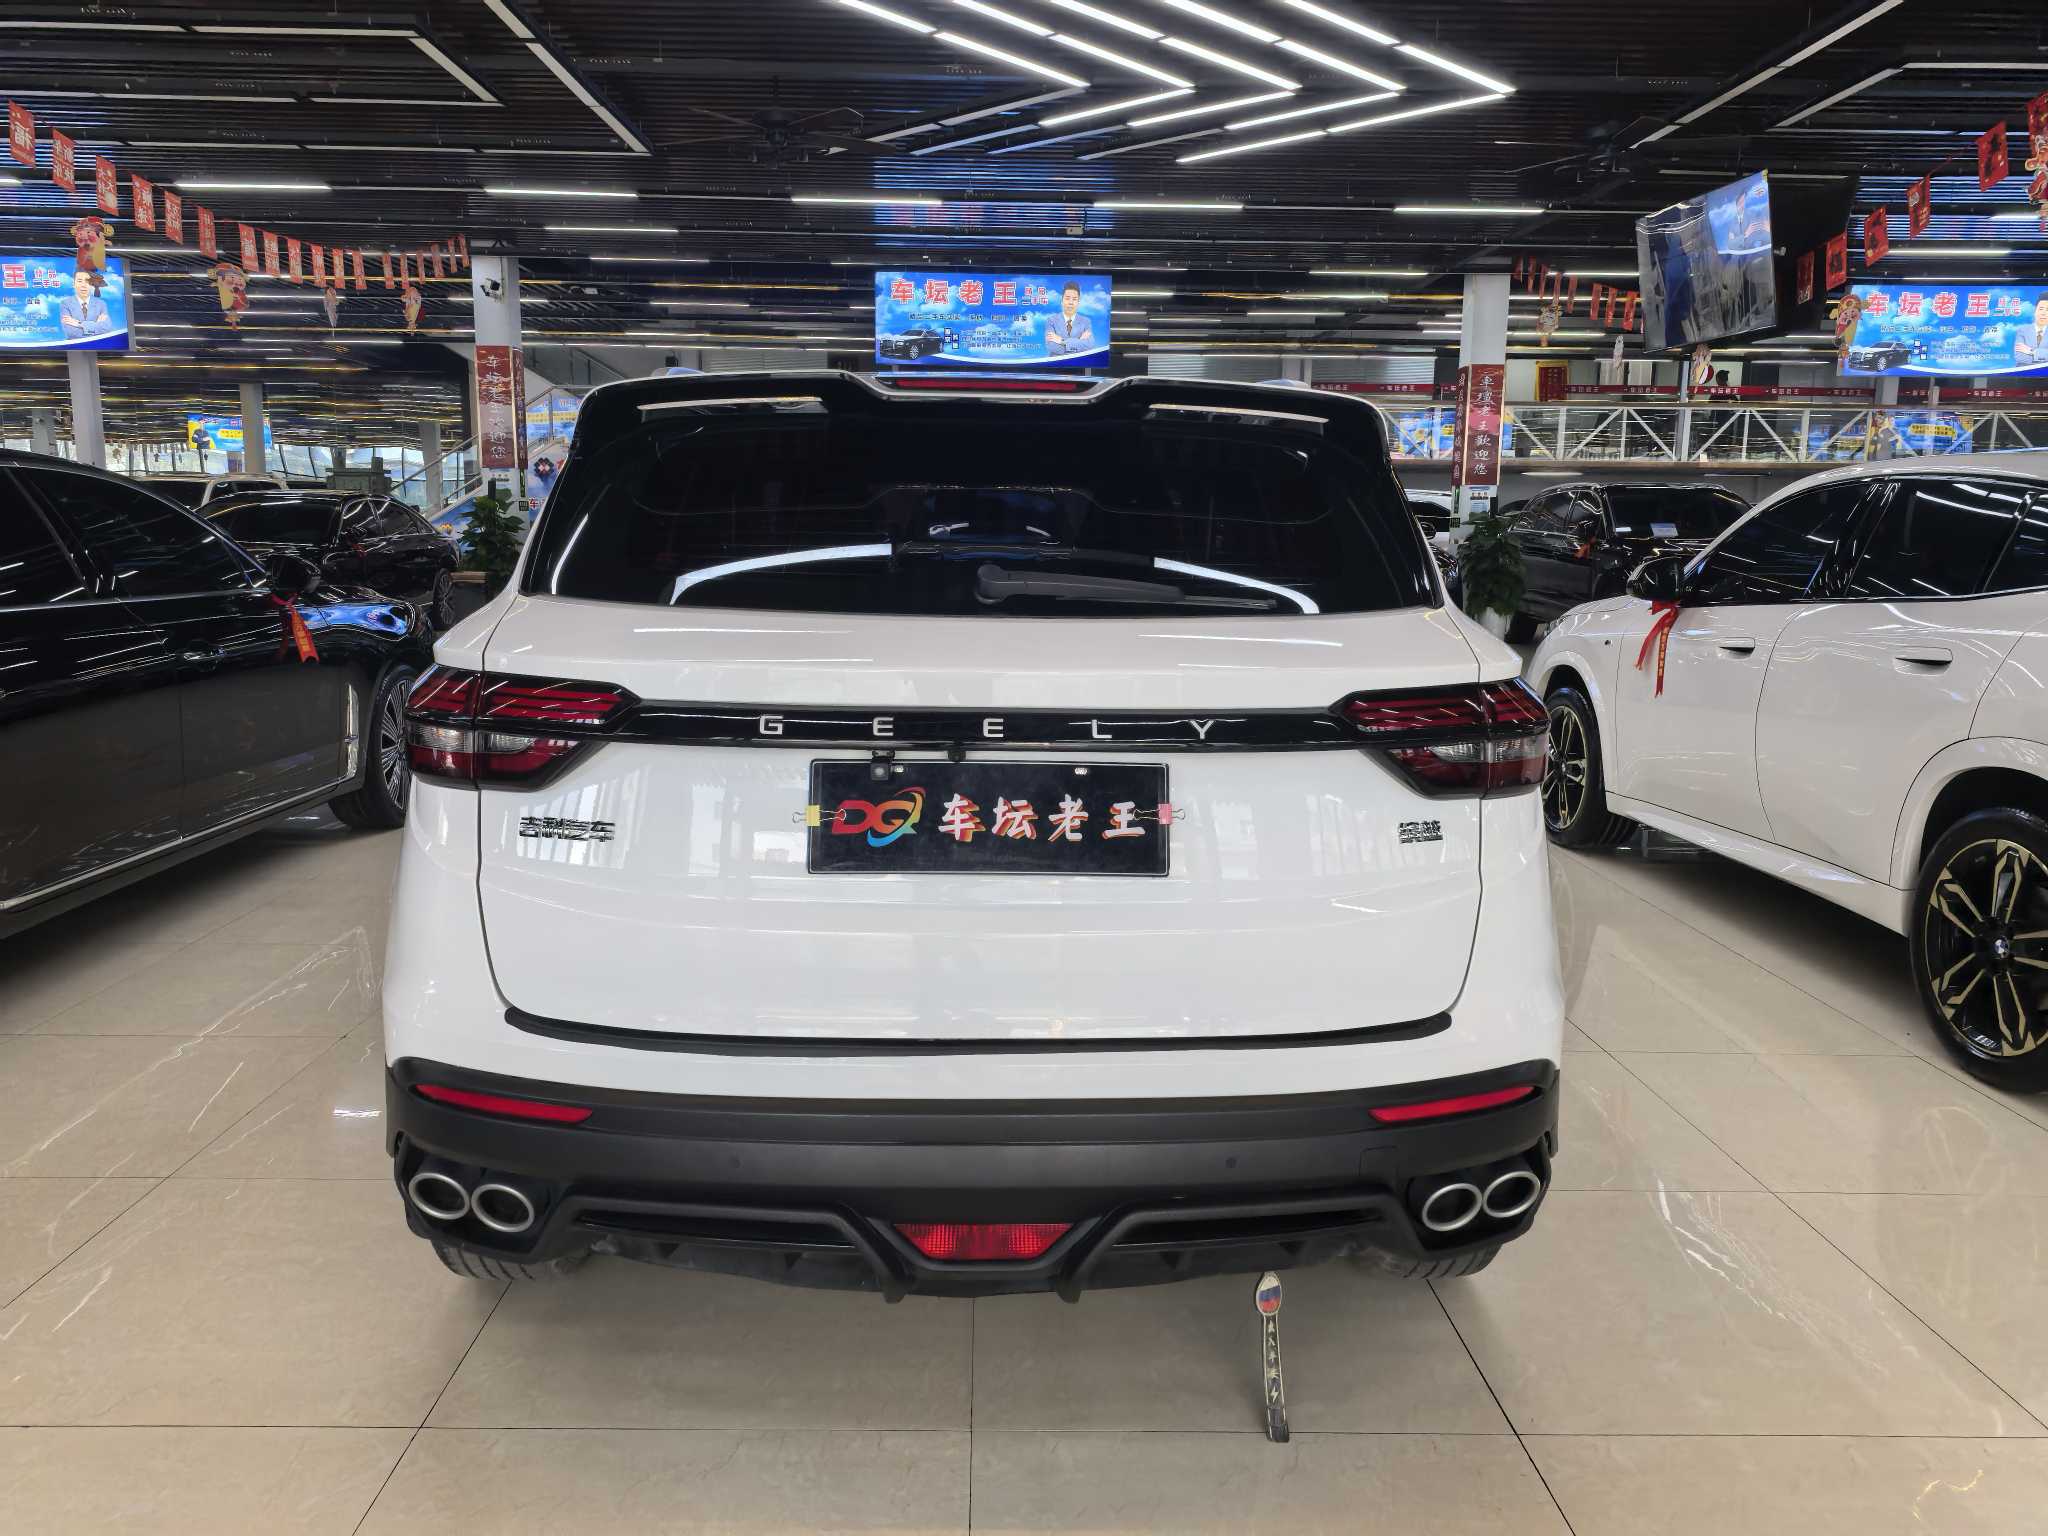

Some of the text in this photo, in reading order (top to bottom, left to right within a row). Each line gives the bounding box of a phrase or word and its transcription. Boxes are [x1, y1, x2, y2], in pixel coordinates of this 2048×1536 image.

[2, 264, 28, 288] 王
[890, 278, 1018, 306] 车坛老王
[1864, 291, 1991, 318] 车坛老王
[758, 714, 1215, 740] GEELY
[938, 793, 1146, 842] 车坛老王
